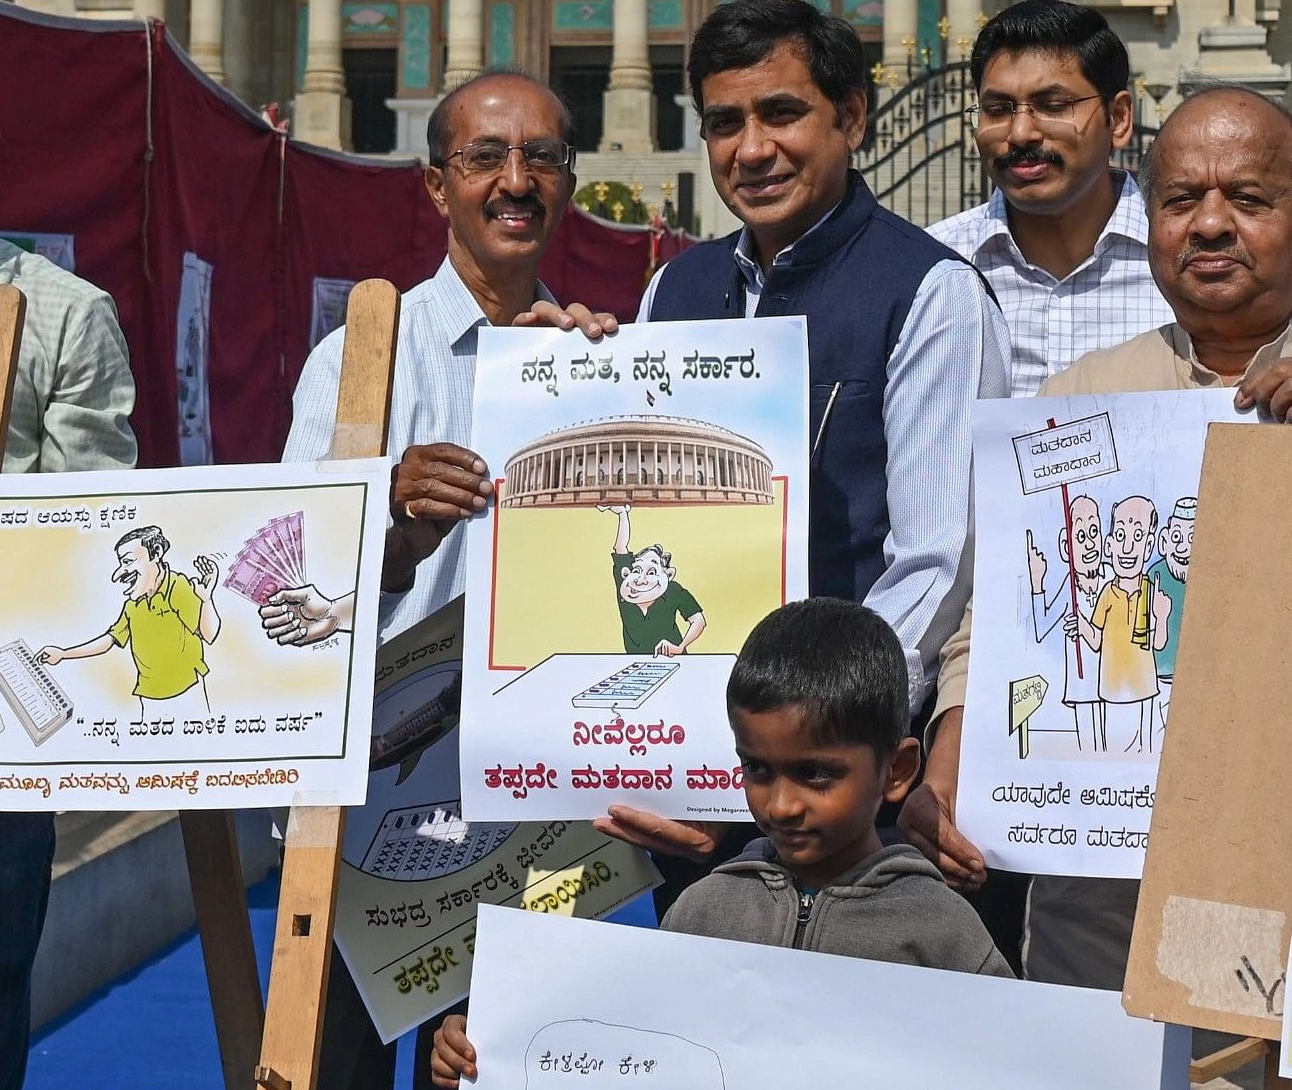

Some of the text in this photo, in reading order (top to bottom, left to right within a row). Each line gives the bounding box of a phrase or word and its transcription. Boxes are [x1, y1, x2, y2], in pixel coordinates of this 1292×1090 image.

[521, 348, 761, 397] ನನ್ನ ಮತ, ನನ್ನ ಸರ್ಕಾರ.
[1031, 429, 1091, 455] ಮತದಾನ
[1033, 451, 1101, 479] ಮಹಾದಾನ
[37, 507, 92, 529] ಆಯಸ್ಸು
[99, 504, 137, 528] ಕ್ಷಣಿಕ
[129, 715, 174, 737] ಮತದ
[183, 714, 227, 736] ಬಾಳಿಕೆ
[235, 715, 266, 734] ಐದು
[573, 718, 686, 756] ನೀವೆಲ್ಲರೂ
[484, 763, 558, 799] ತಪ್ಪದೇ
[571, 764, 673, 790] ಮತದಾನ
[992, 782, 1071, 808] ಯಾವುದೇ
[1008, 822, 1149, 848] ಸರ್ವರೂ ಮತದಾ
[519, 860, 619, 914] ಲಾಯಿಸಿರಿ.
[366, 899, 432, 928] ಸುಭದ್ರ
